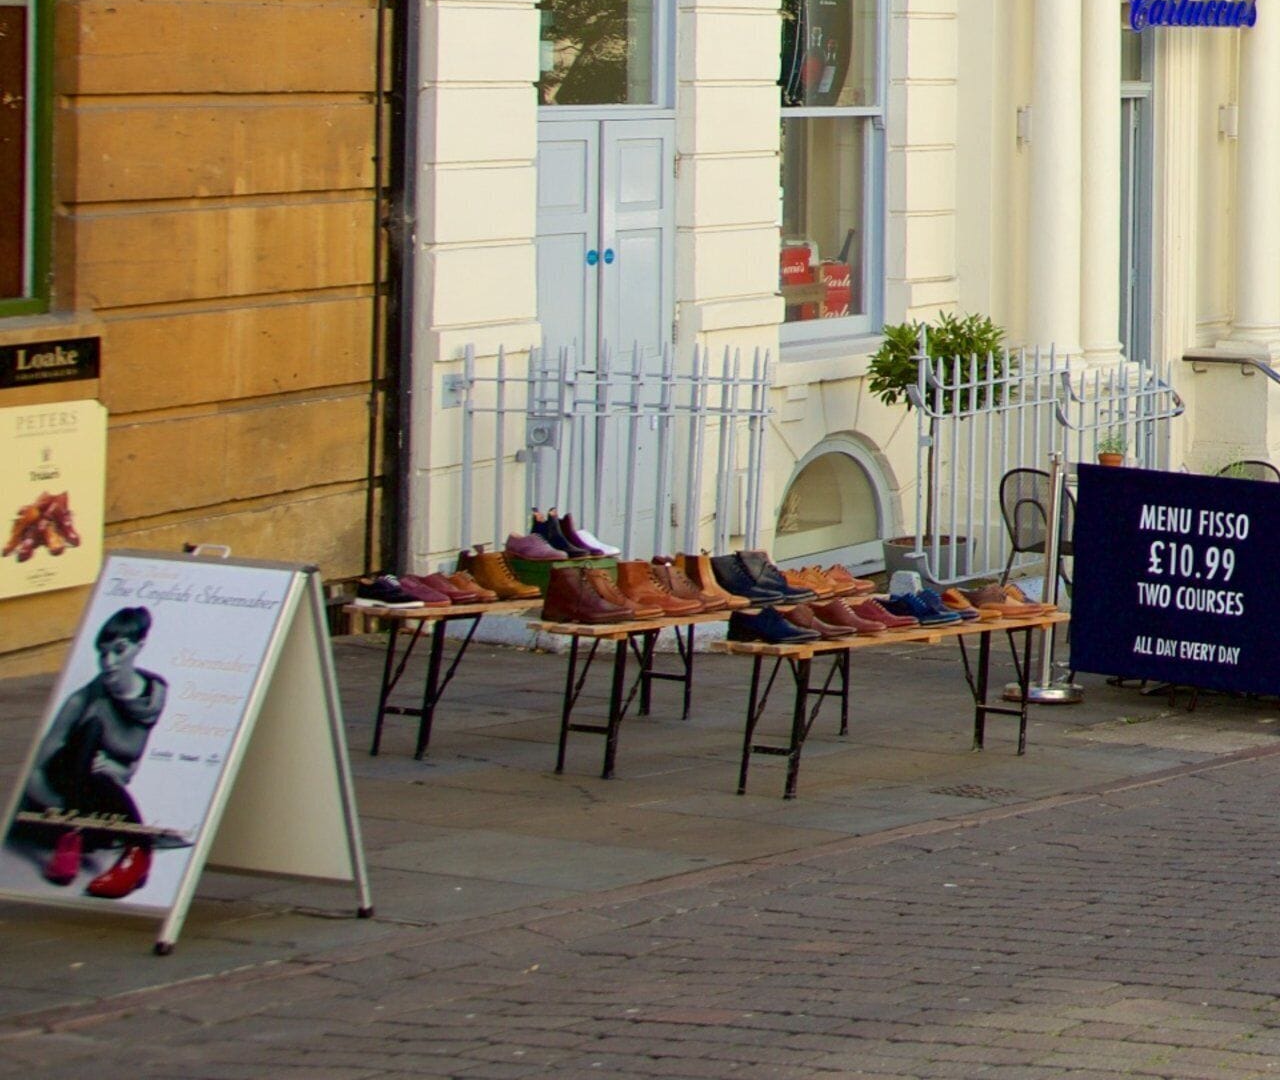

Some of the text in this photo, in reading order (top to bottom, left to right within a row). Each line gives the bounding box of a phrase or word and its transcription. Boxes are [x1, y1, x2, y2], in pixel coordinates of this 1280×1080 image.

[16, 345, 79, 371] Loake
[1139, 504, 1250, 540] MENU FISSO
[1148, 540, 1236, 582] £10.99
[1137, 581, 1245, 616] TWO COURSES
[1133, 635, 1241, 665] ALL DAY EVERY DAY
